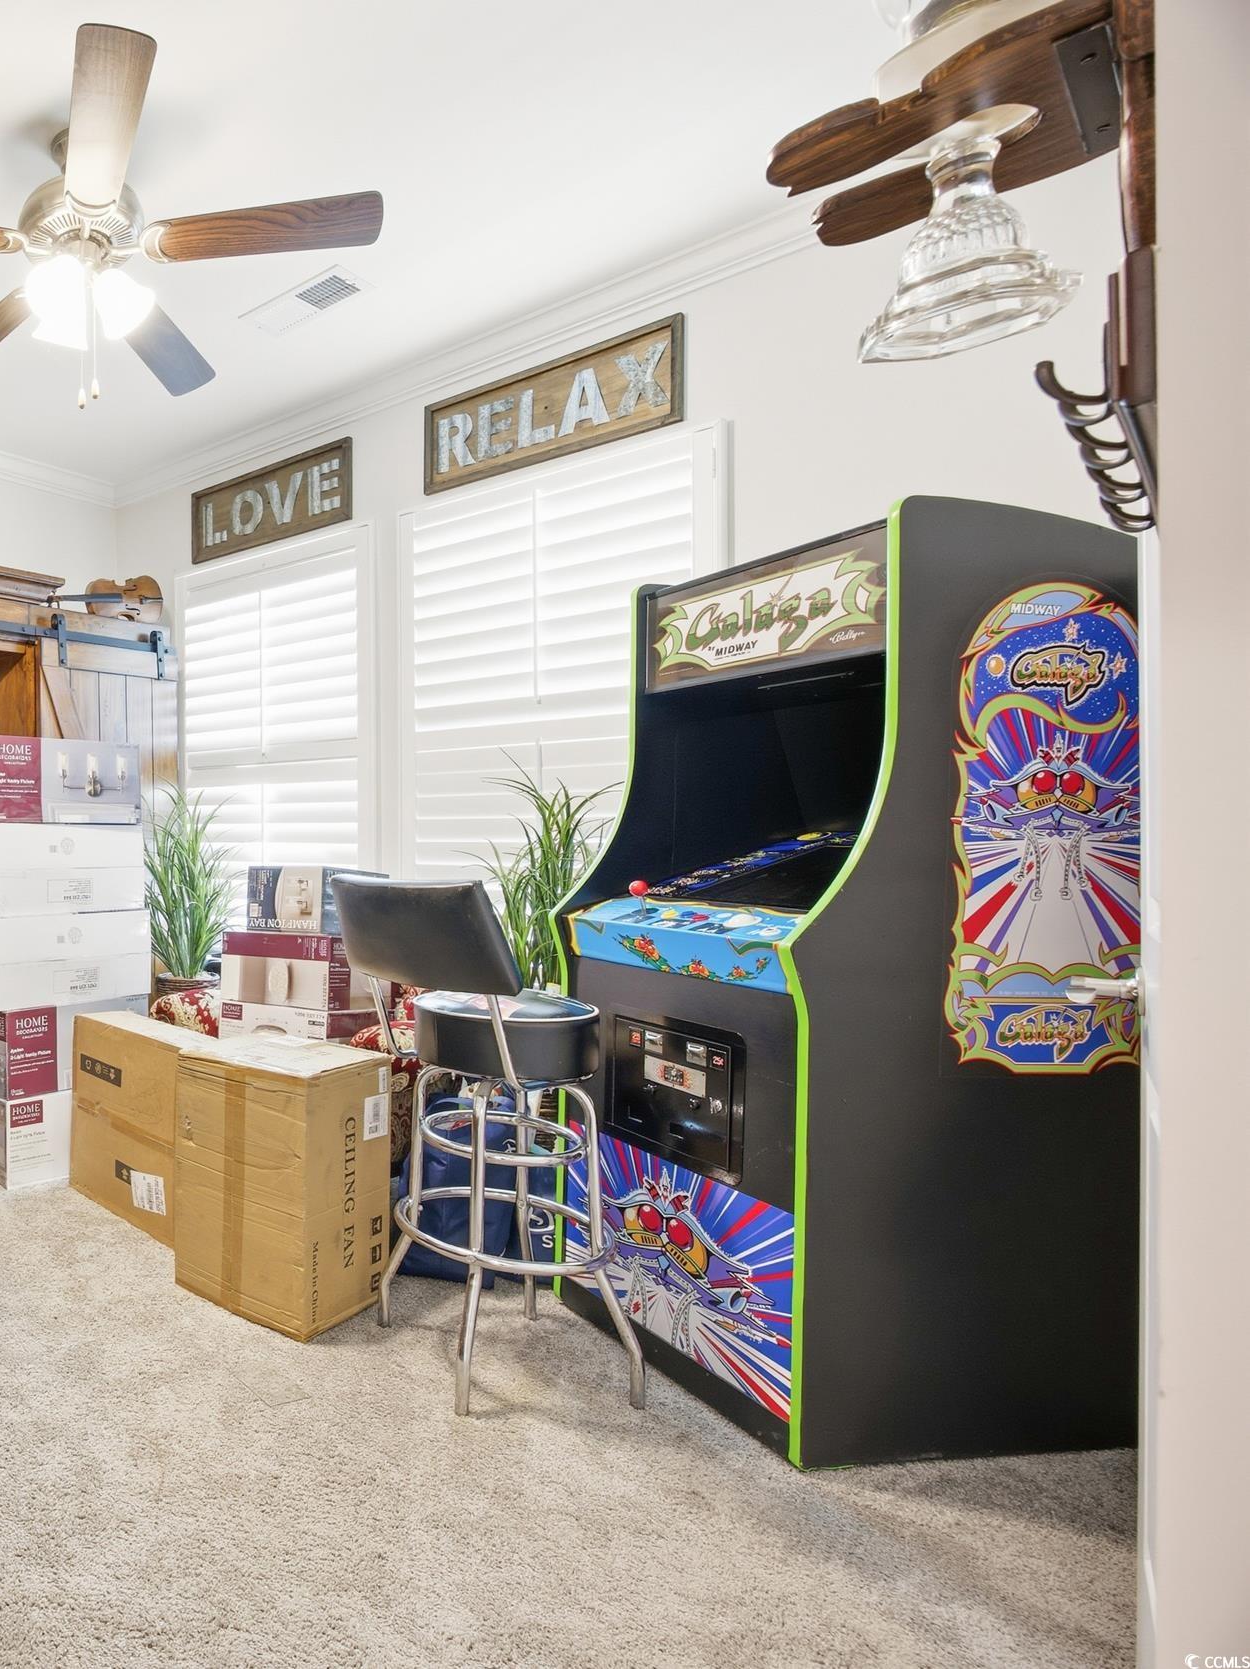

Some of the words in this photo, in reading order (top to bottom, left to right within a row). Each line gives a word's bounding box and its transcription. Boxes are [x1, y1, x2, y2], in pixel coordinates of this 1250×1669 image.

[436, 340, 670, 474] RELAX
[202, 458, 341, 548] LOVE
[684, 585, 839, 655] Galaga
[1010, 603, 1062, 616] MIDWAY
[714, 640, 758, 657] MIDWAY
[1013, 647, 1103, 701] Galaga
[249, 918, 266, 928] BAY
[267, 918, 318, 930] HAMPTON
[15, 1015, 48, 1030] HOME
[996, 1005, 1092, 1063] Galaga
[12, 1103, 41, 1116] HOME
[343, 1116, 356, 1214] CEILING
[311, 1241, 319, 1273] Made
[343, 1224, 355, 1269] FAN
[311, 1289, 319, 1324] China
